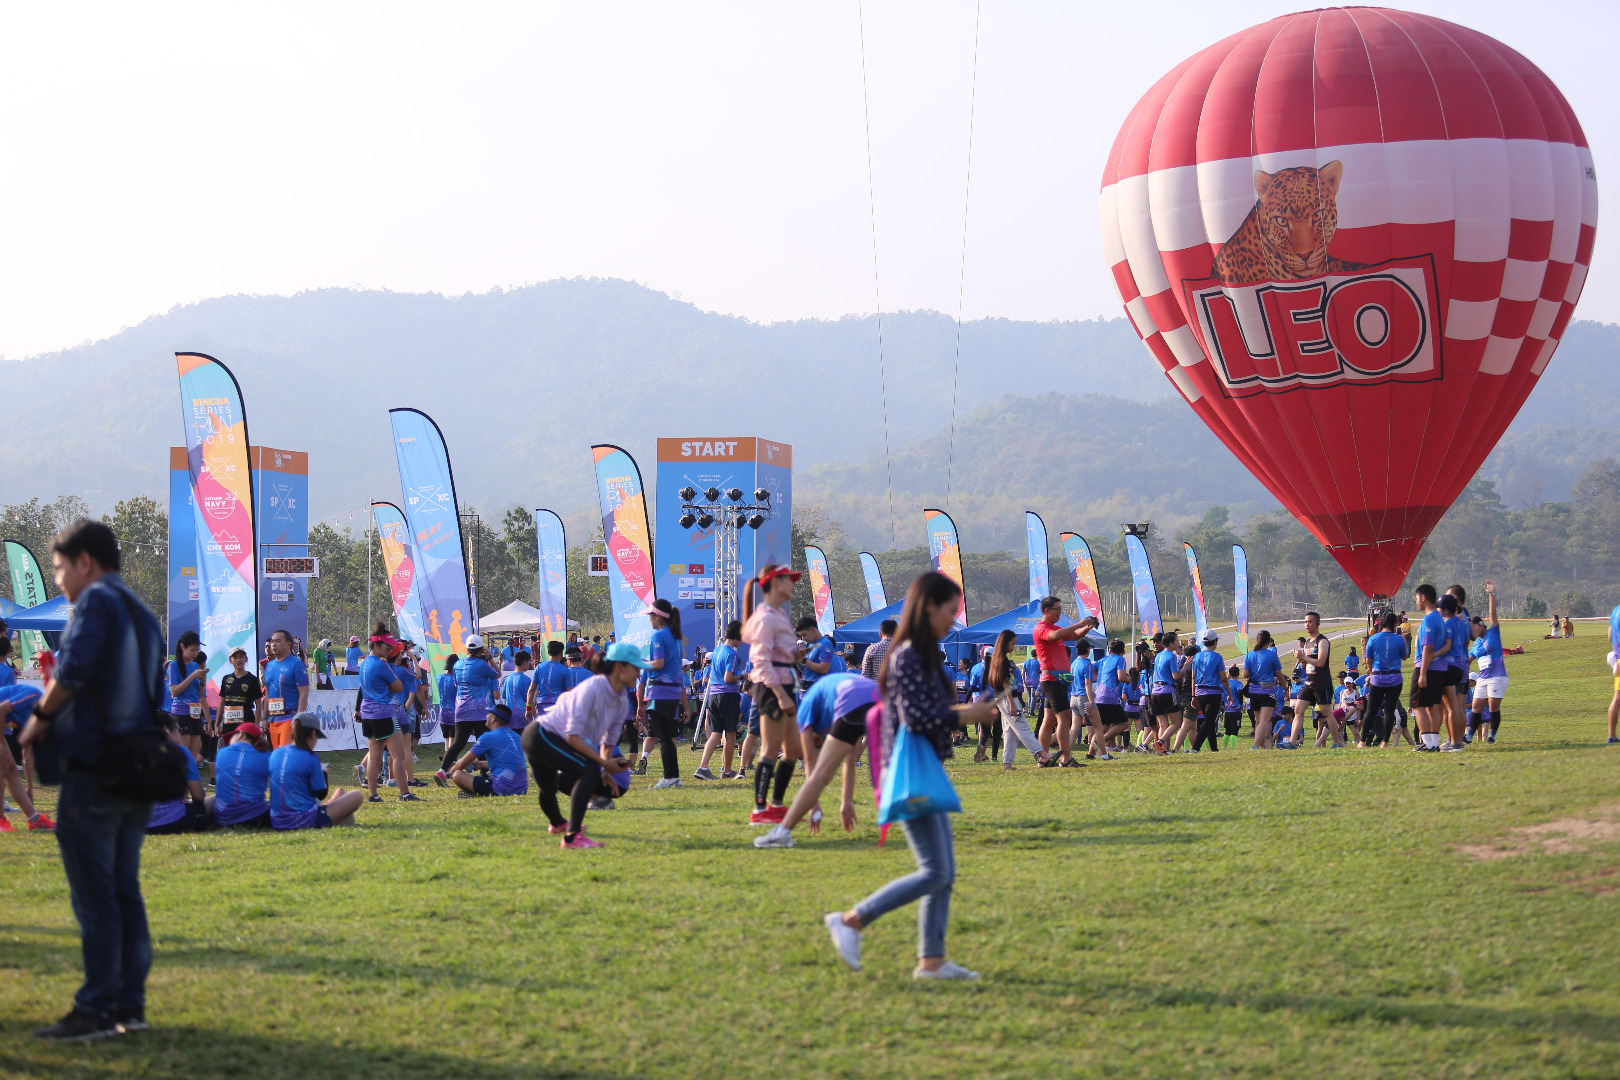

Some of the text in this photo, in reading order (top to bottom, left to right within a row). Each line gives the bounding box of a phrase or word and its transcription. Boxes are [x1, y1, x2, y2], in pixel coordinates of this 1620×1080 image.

[1200, 274, 1427, 384] LEO
[192, 397, 230, 407] SINGHA
[193, 405, 232, 416] SERIES
[196, 435, 235, 445] 2019
[681, 441, 738, 457] START
[605, 481, 634, 491] SERIES
[204, 500, 227, 508] NAVY
[270, 496, 296, 509] SP XC
[408, 493, 450, 505] SP XC
[415, 521, 443, 547] BEAT
[224, 543, 241, 551] KOM
[202, 610, 242, 631] BEAT
[210, 622, 254, 637] YOURSELF
